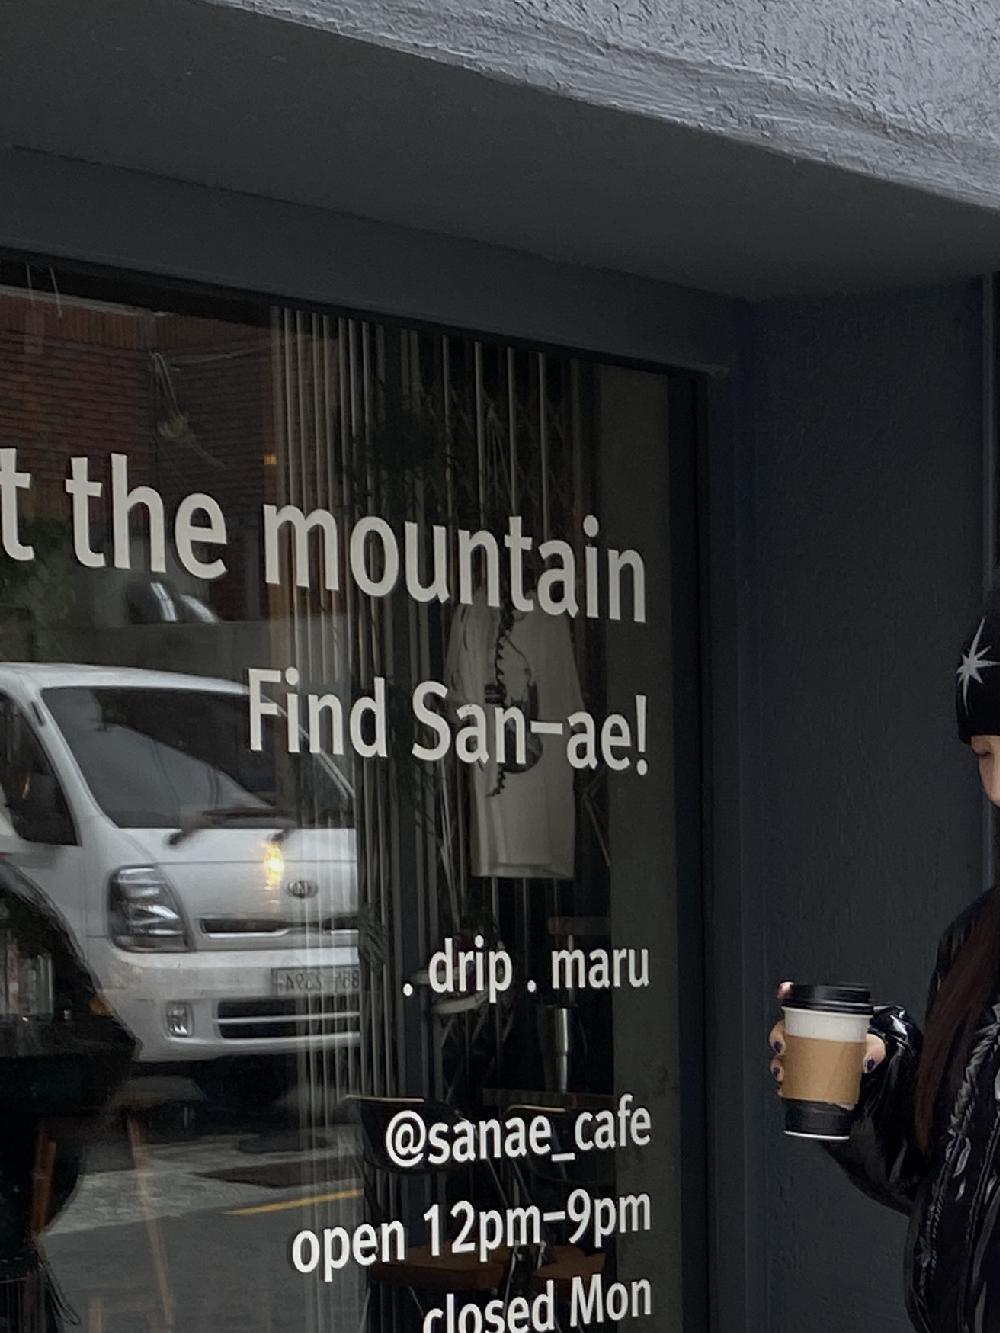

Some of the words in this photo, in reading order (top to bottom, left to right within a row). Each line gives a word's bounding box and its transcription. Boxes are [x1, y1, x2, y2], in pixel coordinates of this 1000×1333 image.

[66, 453, 227, 580] the
[264, 504, 646, 623] mountain
[248, 666, 388, 758] Find
[412, 681, 648, 776] San-ae!
[552, 947, 650, 990] maru
[385, 1094, 651, 1168] @sanae_cafe
[292, 1220, 406, 1283] open
[423, 1188, 651, 1263] 12pm-9pm
[570, 1273, 652, 1327] Mon
